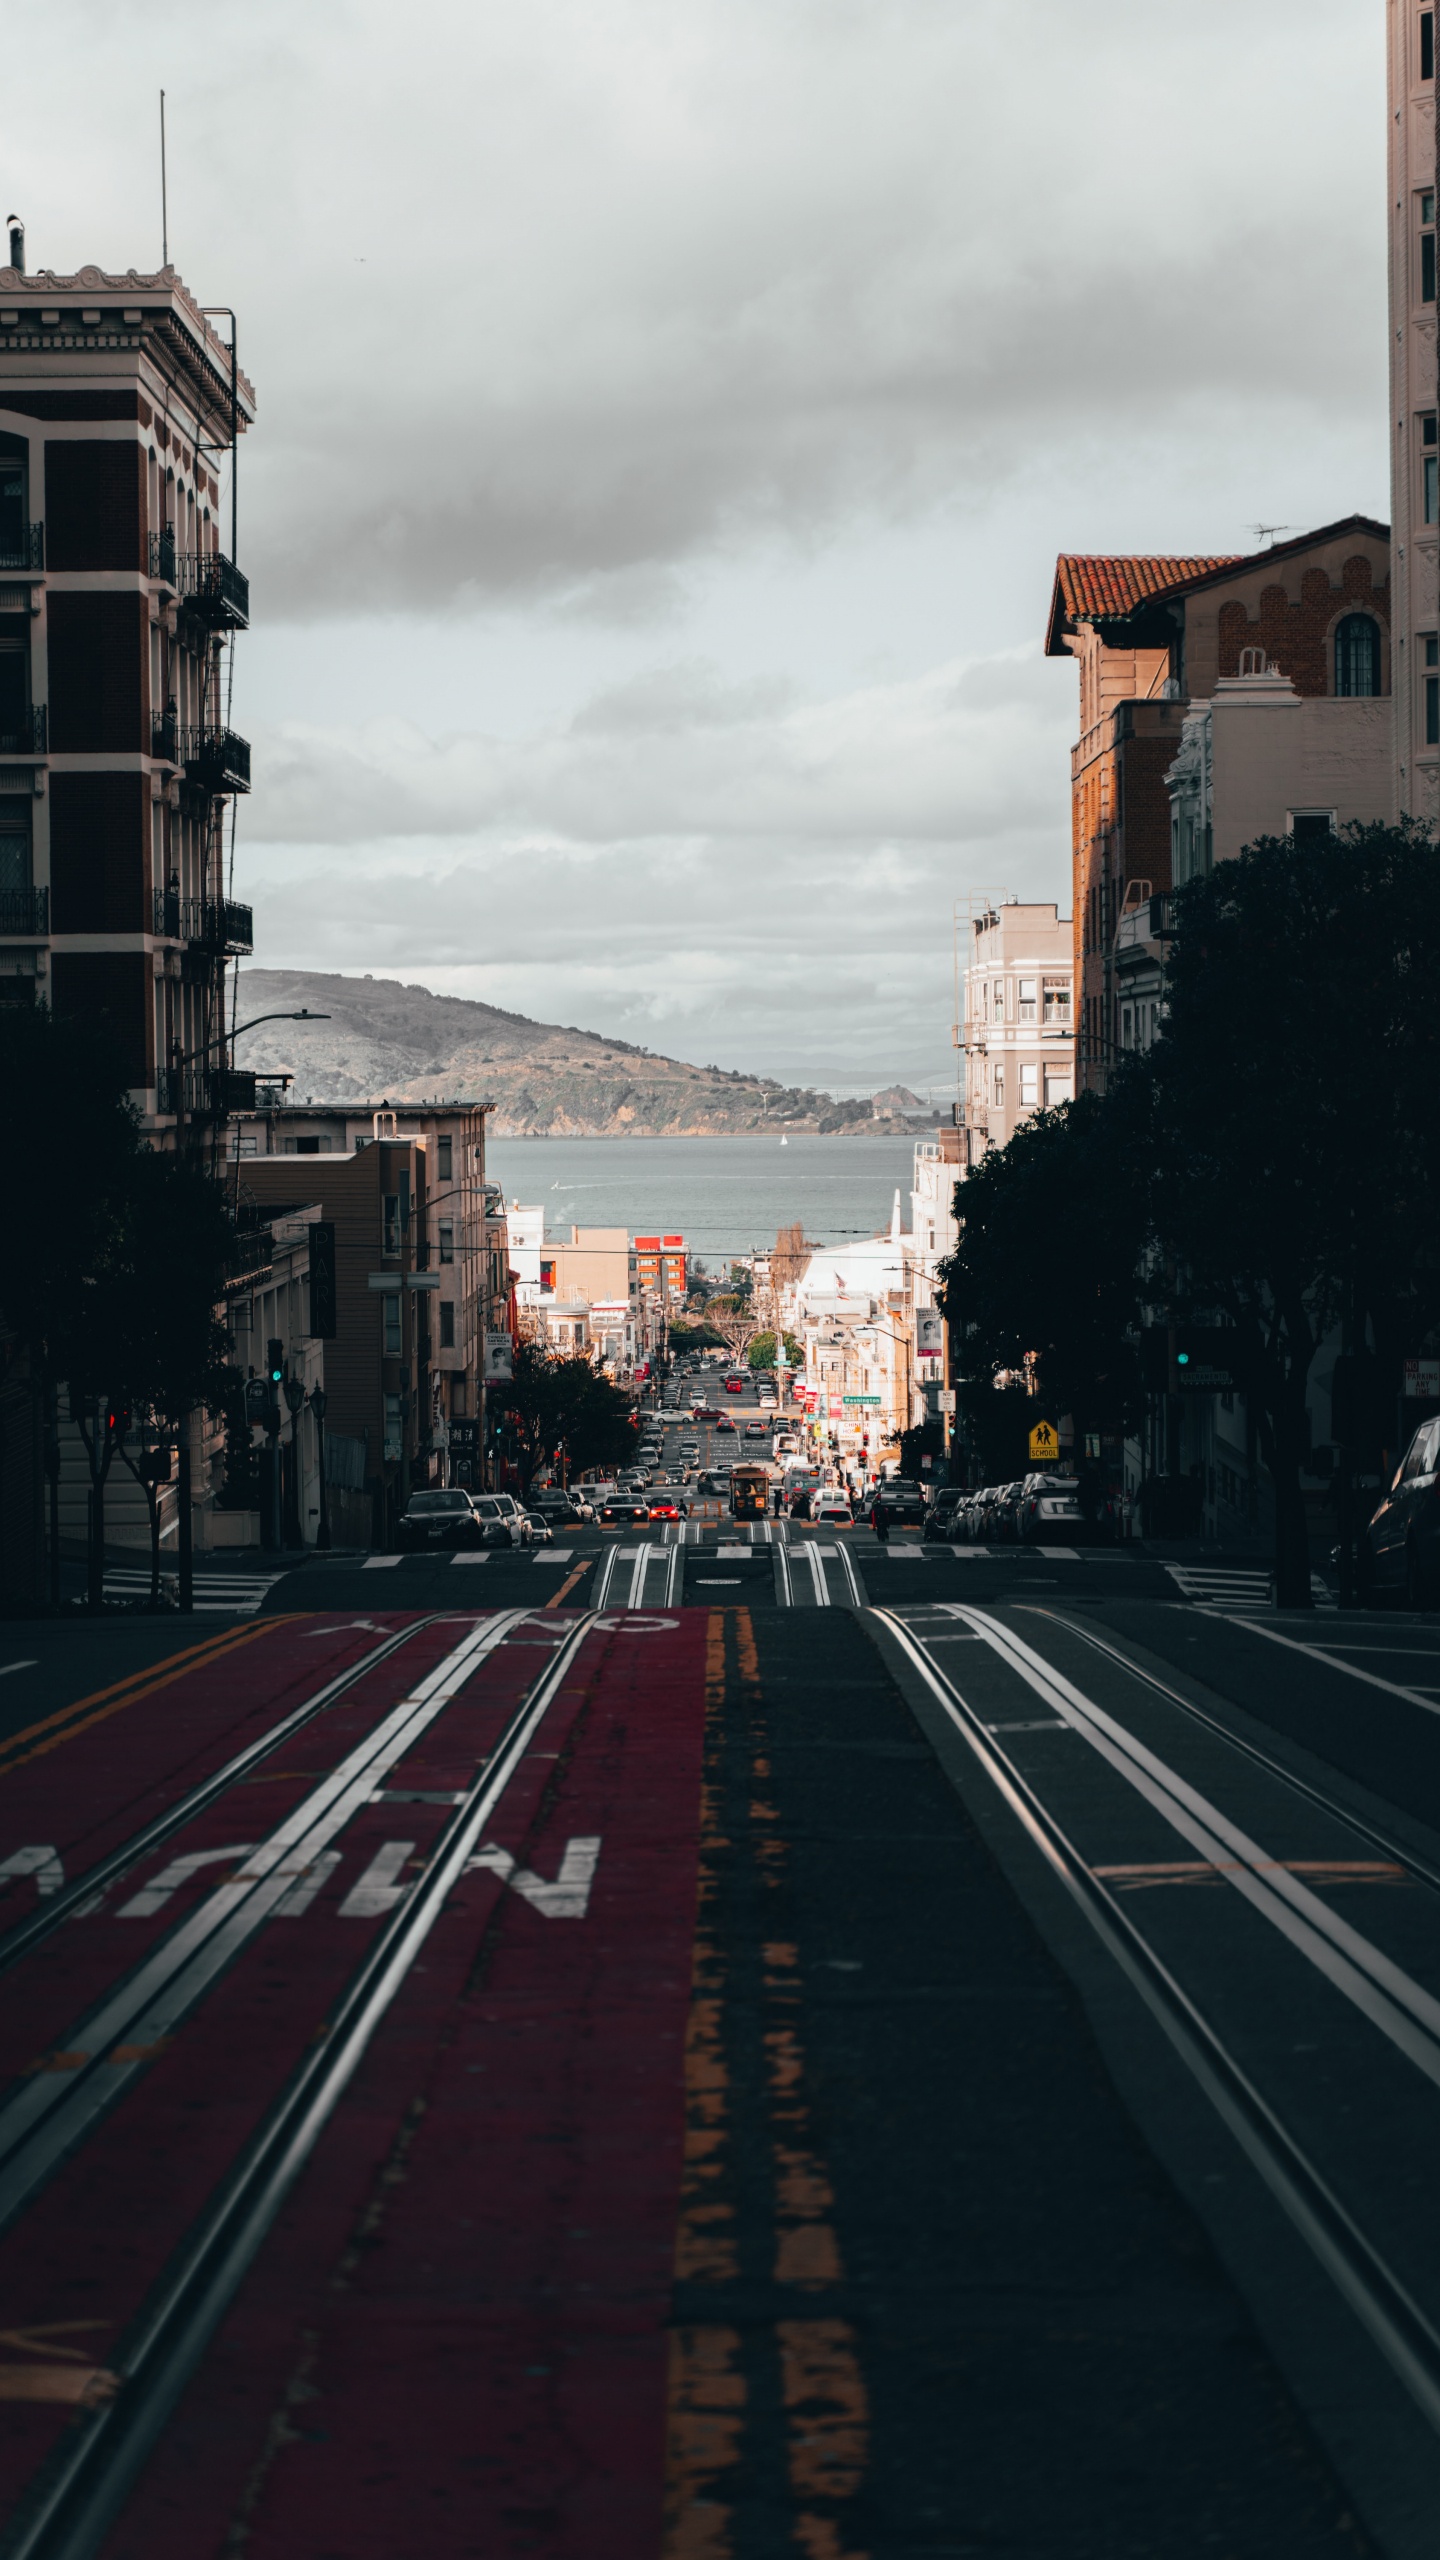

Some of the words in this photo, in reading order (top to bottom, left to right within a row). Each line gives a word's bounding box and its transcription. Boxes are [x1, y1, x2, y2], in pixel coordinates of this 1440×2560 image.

[314, 1230, 329, 1334] PARK
[1406, 1361, 1418, 1371] NO
[1182, 1373, 1228, 1381] SACRAMENTO
[1408, 1373, 1438, 1381] PARKING
[1415, 1388, 1430, 1396] TIME
[1031, 1449, 1057, 1457] SCHOOL
